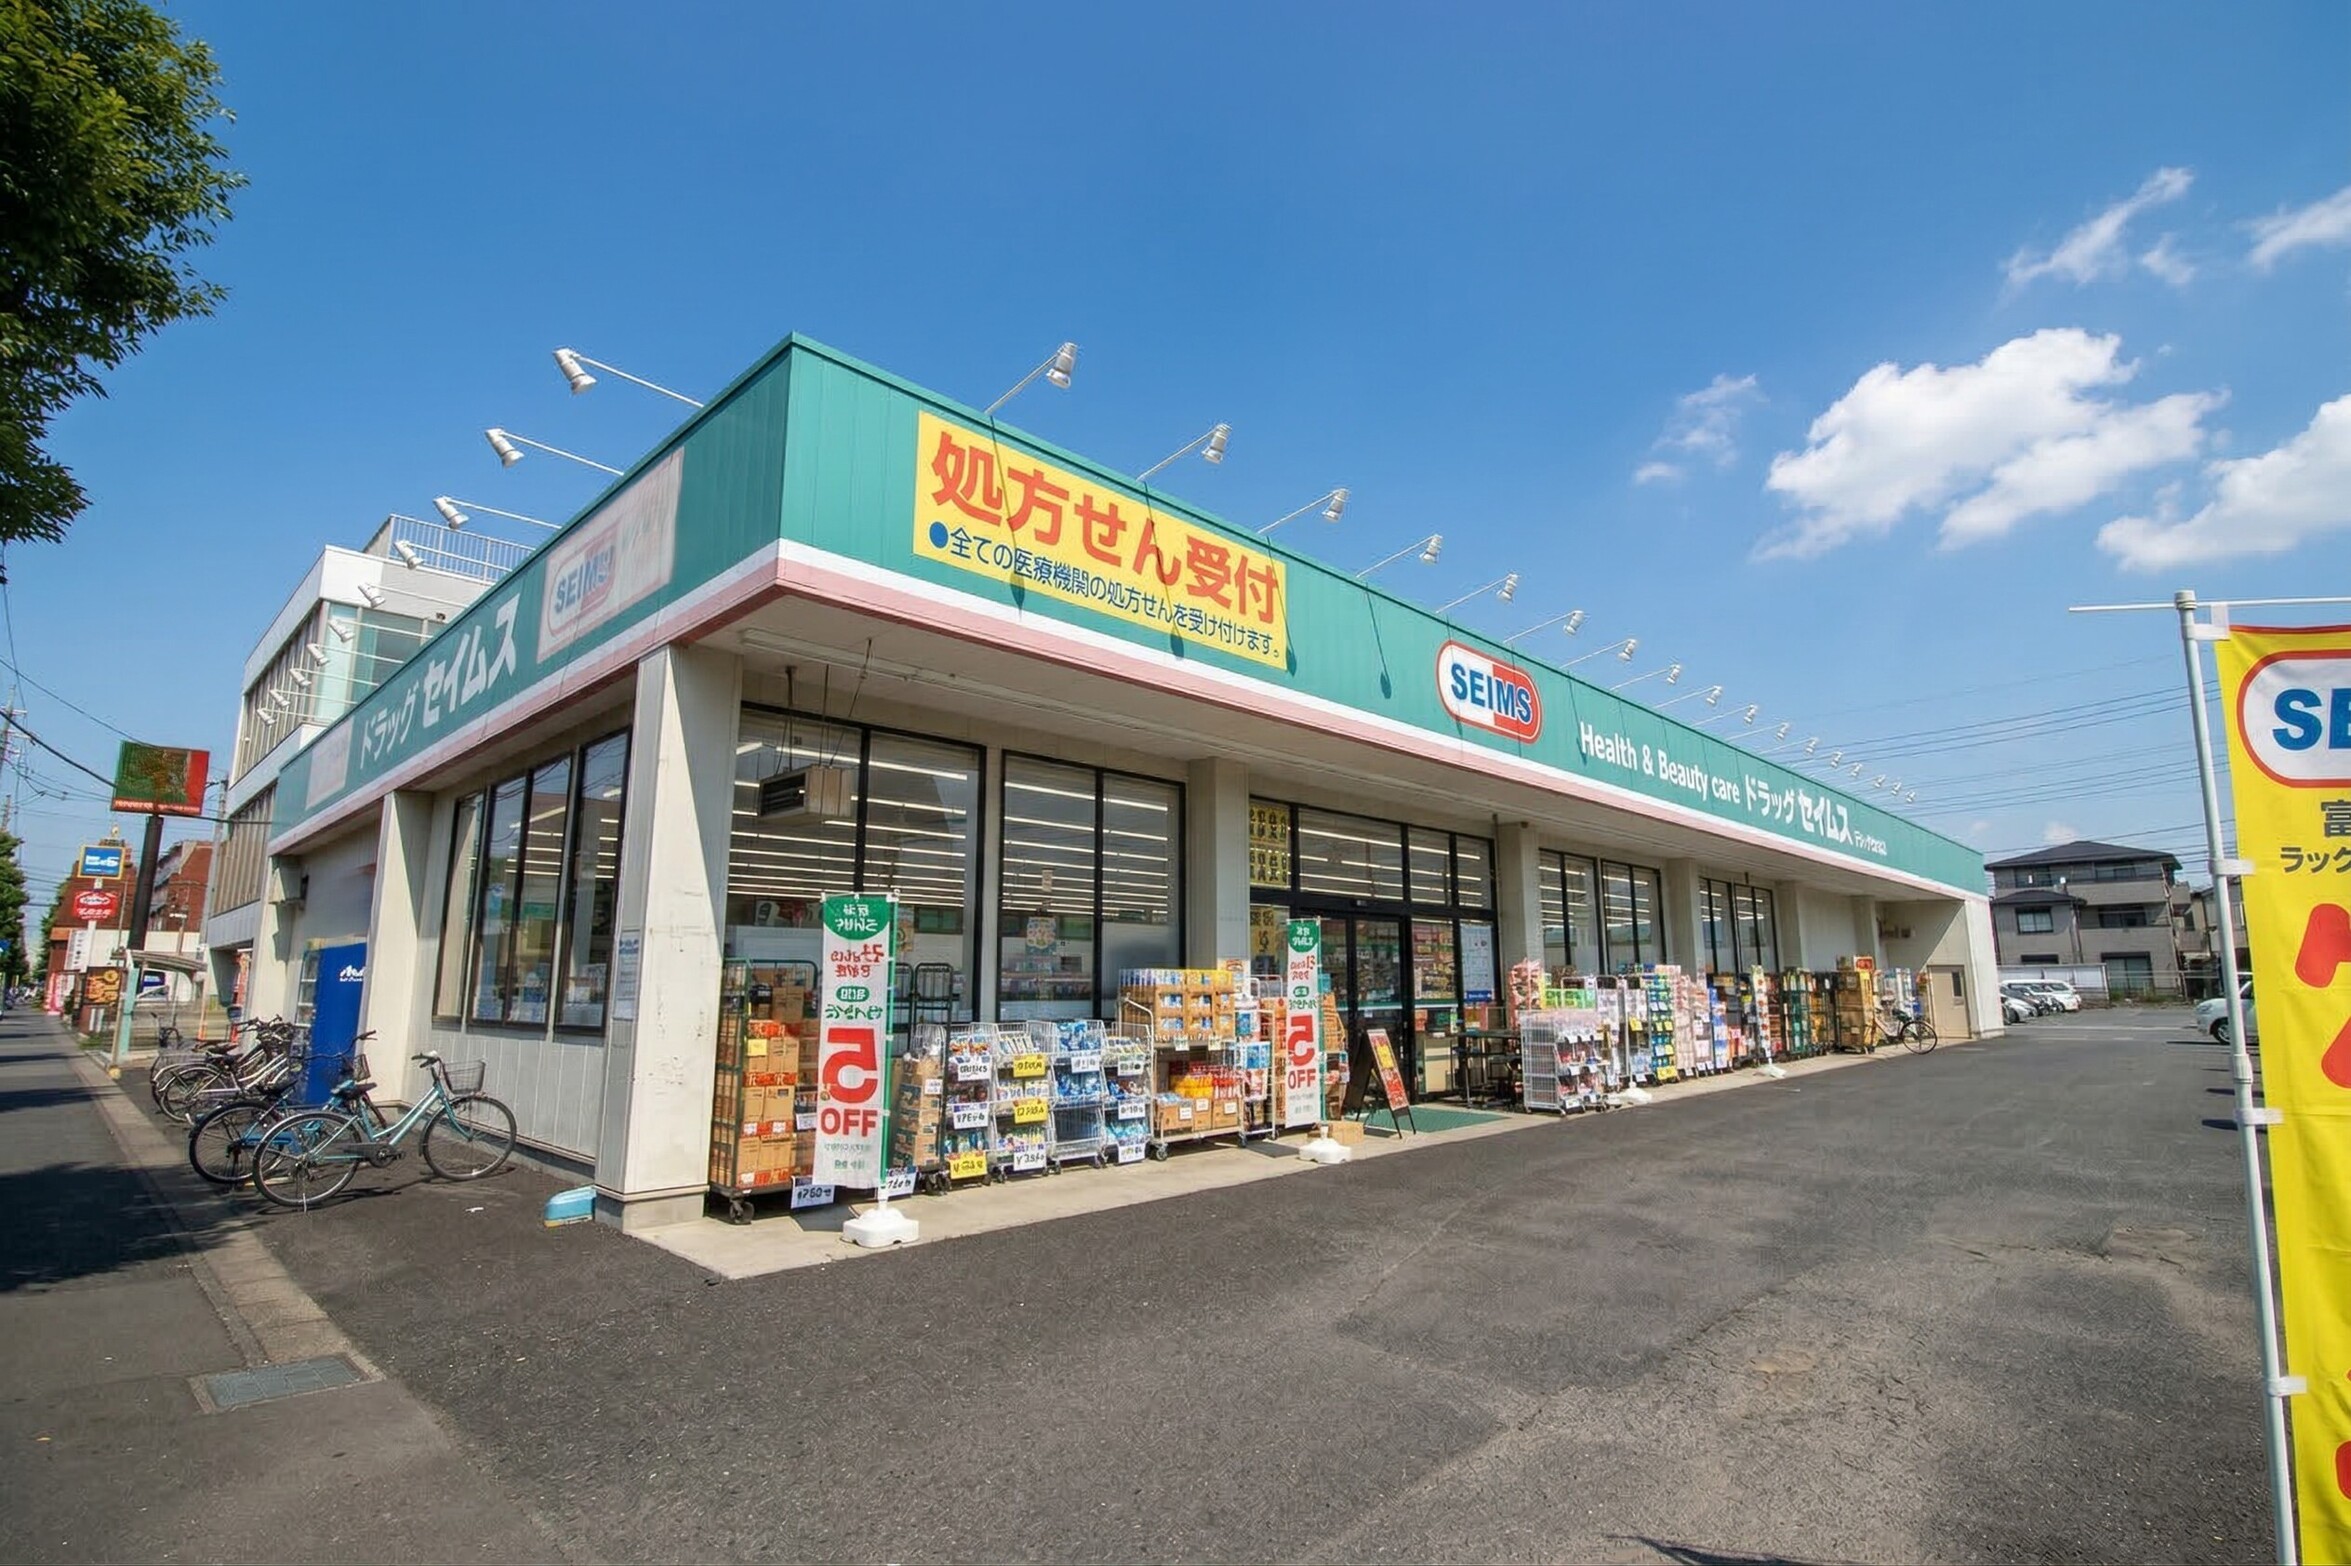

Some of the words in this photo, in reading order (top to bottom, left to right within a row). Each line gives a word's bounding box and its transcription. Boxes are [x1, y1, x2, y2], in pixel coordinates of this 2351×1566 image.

[931, 431, 1278, 625] 処方せん受付
[1451, 663, 1532, 723] SEIMS
[1580, 721, 1638, 771] Health
[1642, 744, 1655, 777] &
[1657, 749, 1709, 801] Beauty
[1711, 776, 1741, 804] care
[1288, 1068, 1317, 1090] OFF
[820, 1107, 879, 1138] OFF
